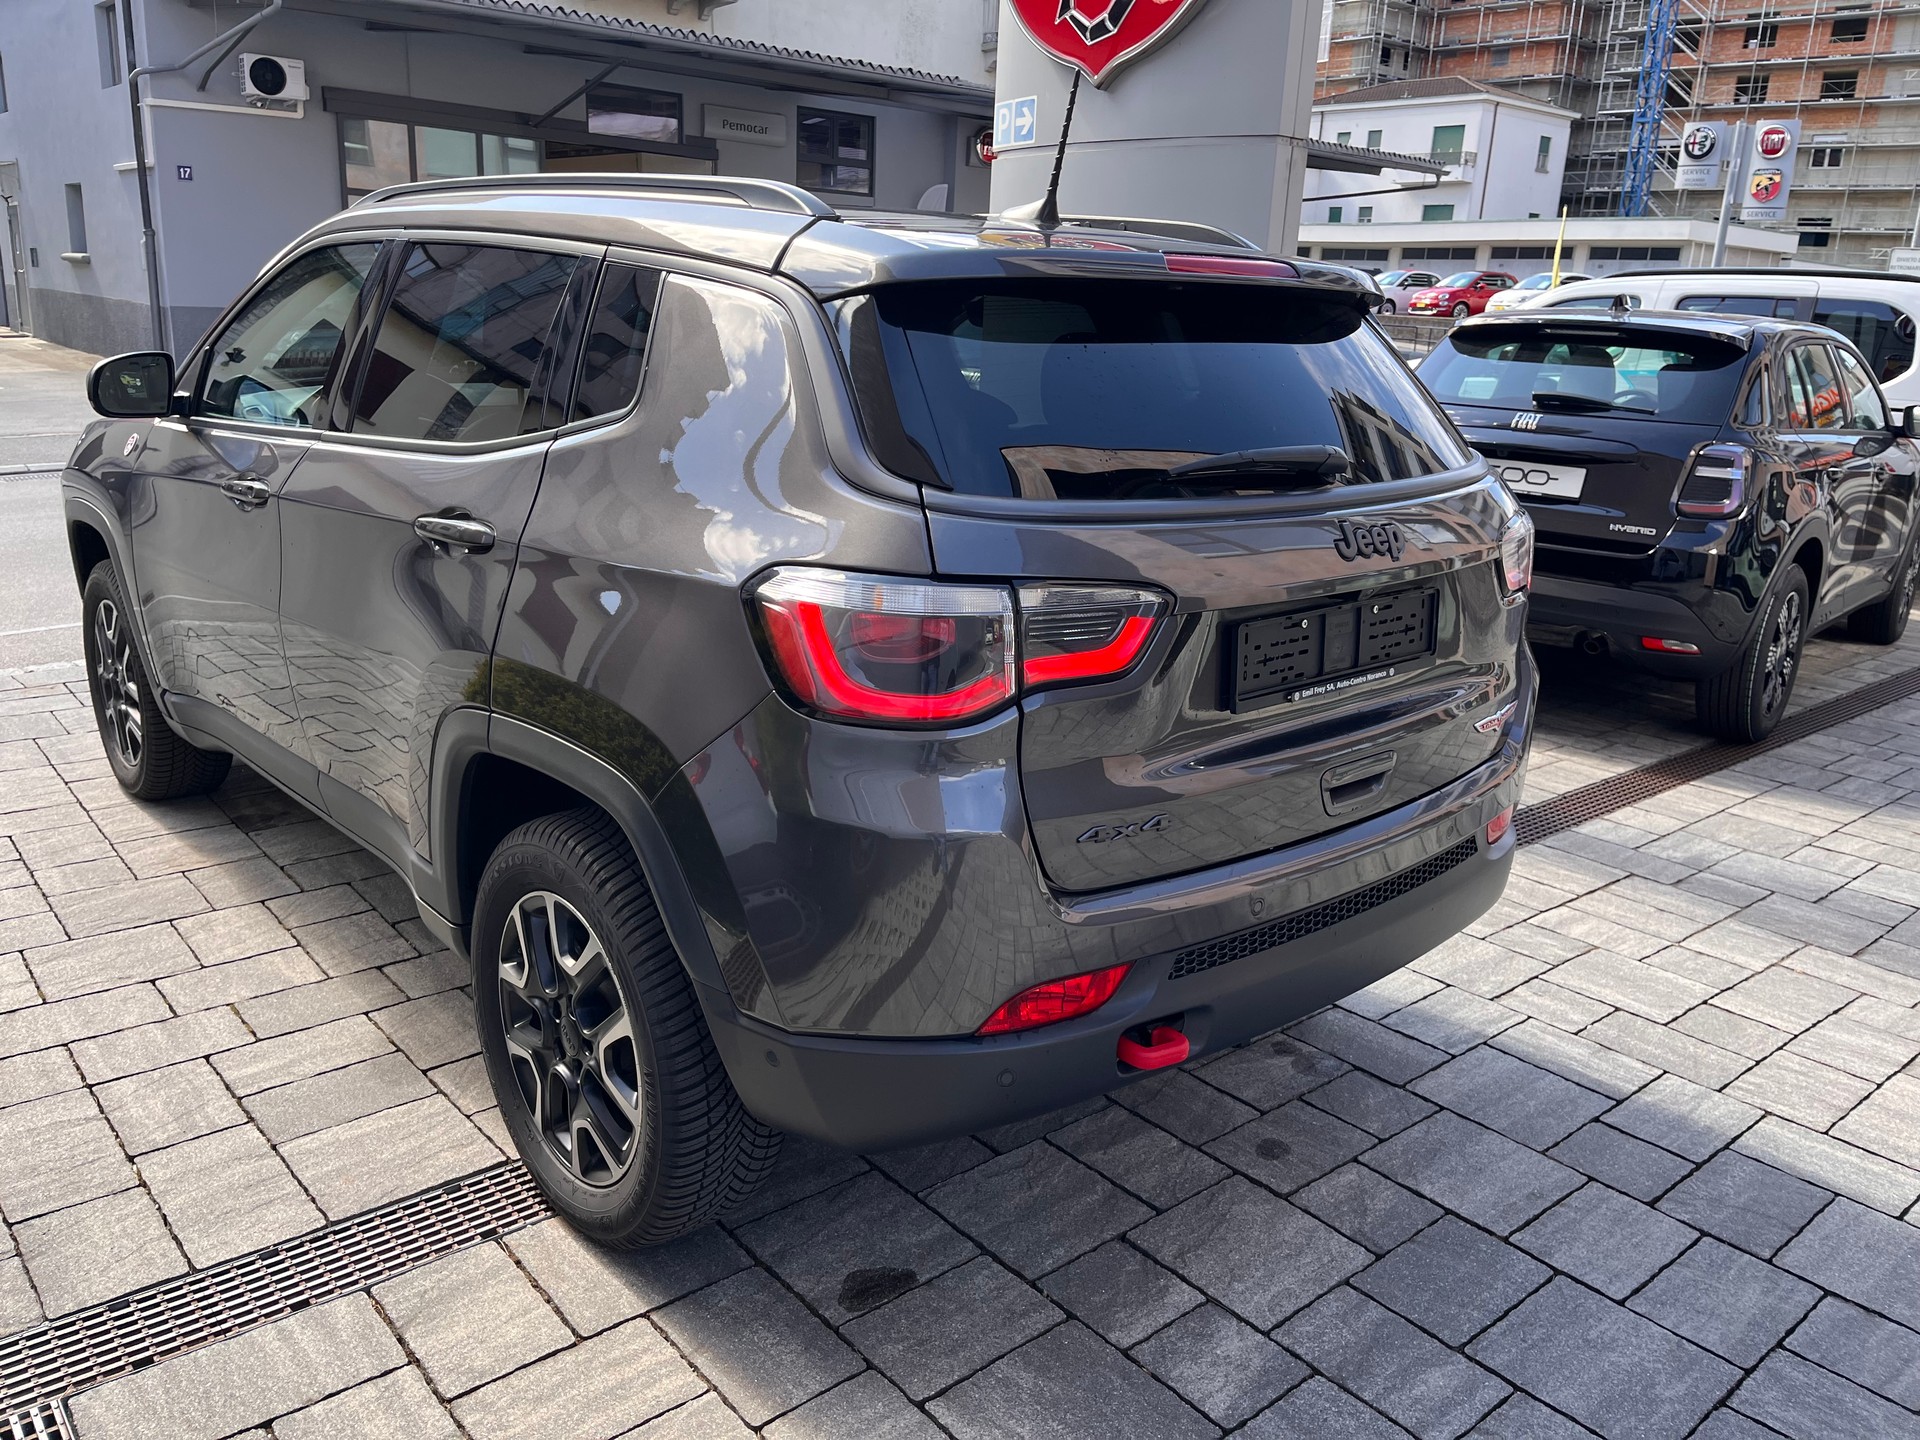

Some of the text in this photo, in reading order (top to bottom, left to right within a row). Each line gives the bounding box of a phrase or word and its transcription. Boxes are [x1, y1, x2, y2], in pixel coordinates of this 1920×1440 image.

[998, 108, 1010, 142] P
[1763, 133, 1786, 150] FIAT
[179, 167, 191, 179] 17
[1682, 168, 1712, 176] SERVICE
[1746, 210, 1778, 218] SERVICE
[1510, 412, 1544, 430] FIAT
[1609, 523, 1657, 536] HYBRID
[1333, 519, 1407, 562] Jeep
[1302, 687, 1314, 698] Emil
[1314, 686, 1326, 695] Frey
[1336, 676, 1367, 689] Auto-Centro
[1367, 670, 1387, 681] Noranco
[1076, 813, 1170, 843] 4x4
